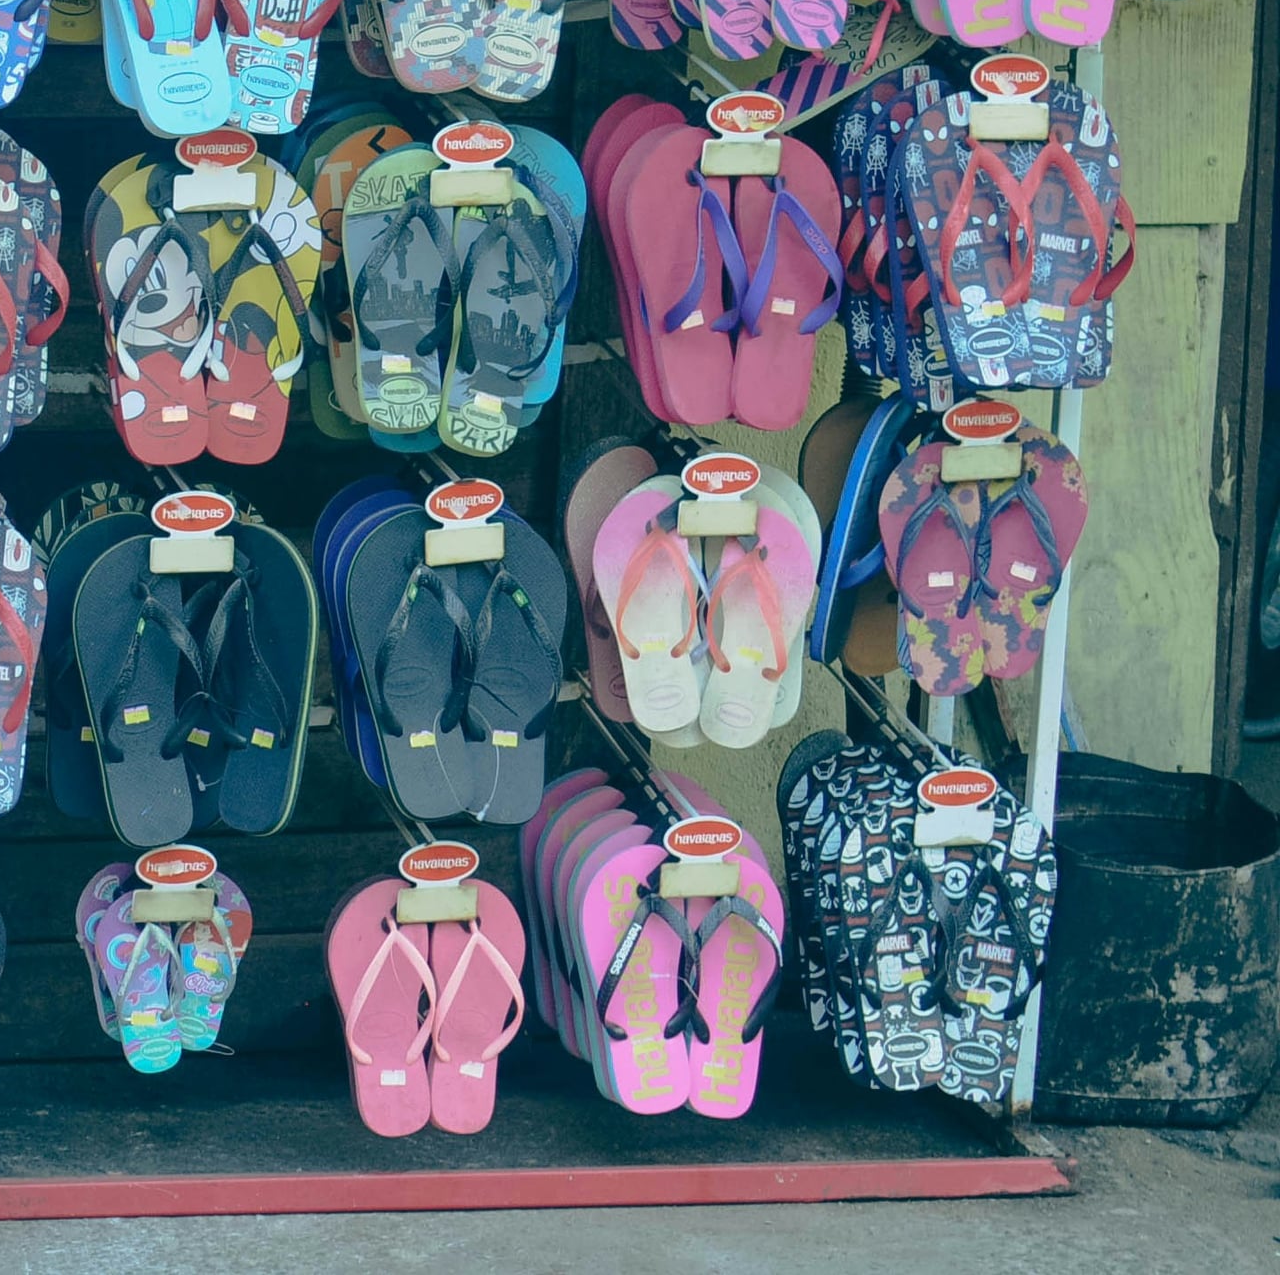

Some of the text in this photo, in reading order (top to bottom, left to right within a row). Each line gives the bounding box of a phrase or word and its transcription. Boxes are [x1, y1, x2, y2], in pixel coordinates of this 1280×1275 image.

[186, 143, 250, 156] havaianas
[1039, 232, 1078, 253] MARVEL
[953, 413, 1014, 426] havaianas
[928, 783, 987, 795] havaianas
[674, 832, 735, 845] havaianas
[410, 857, 471, 871] havaianas
[610, 923, 643, 976] havaianas
[976, 943, 1013, 962] MARVEL
